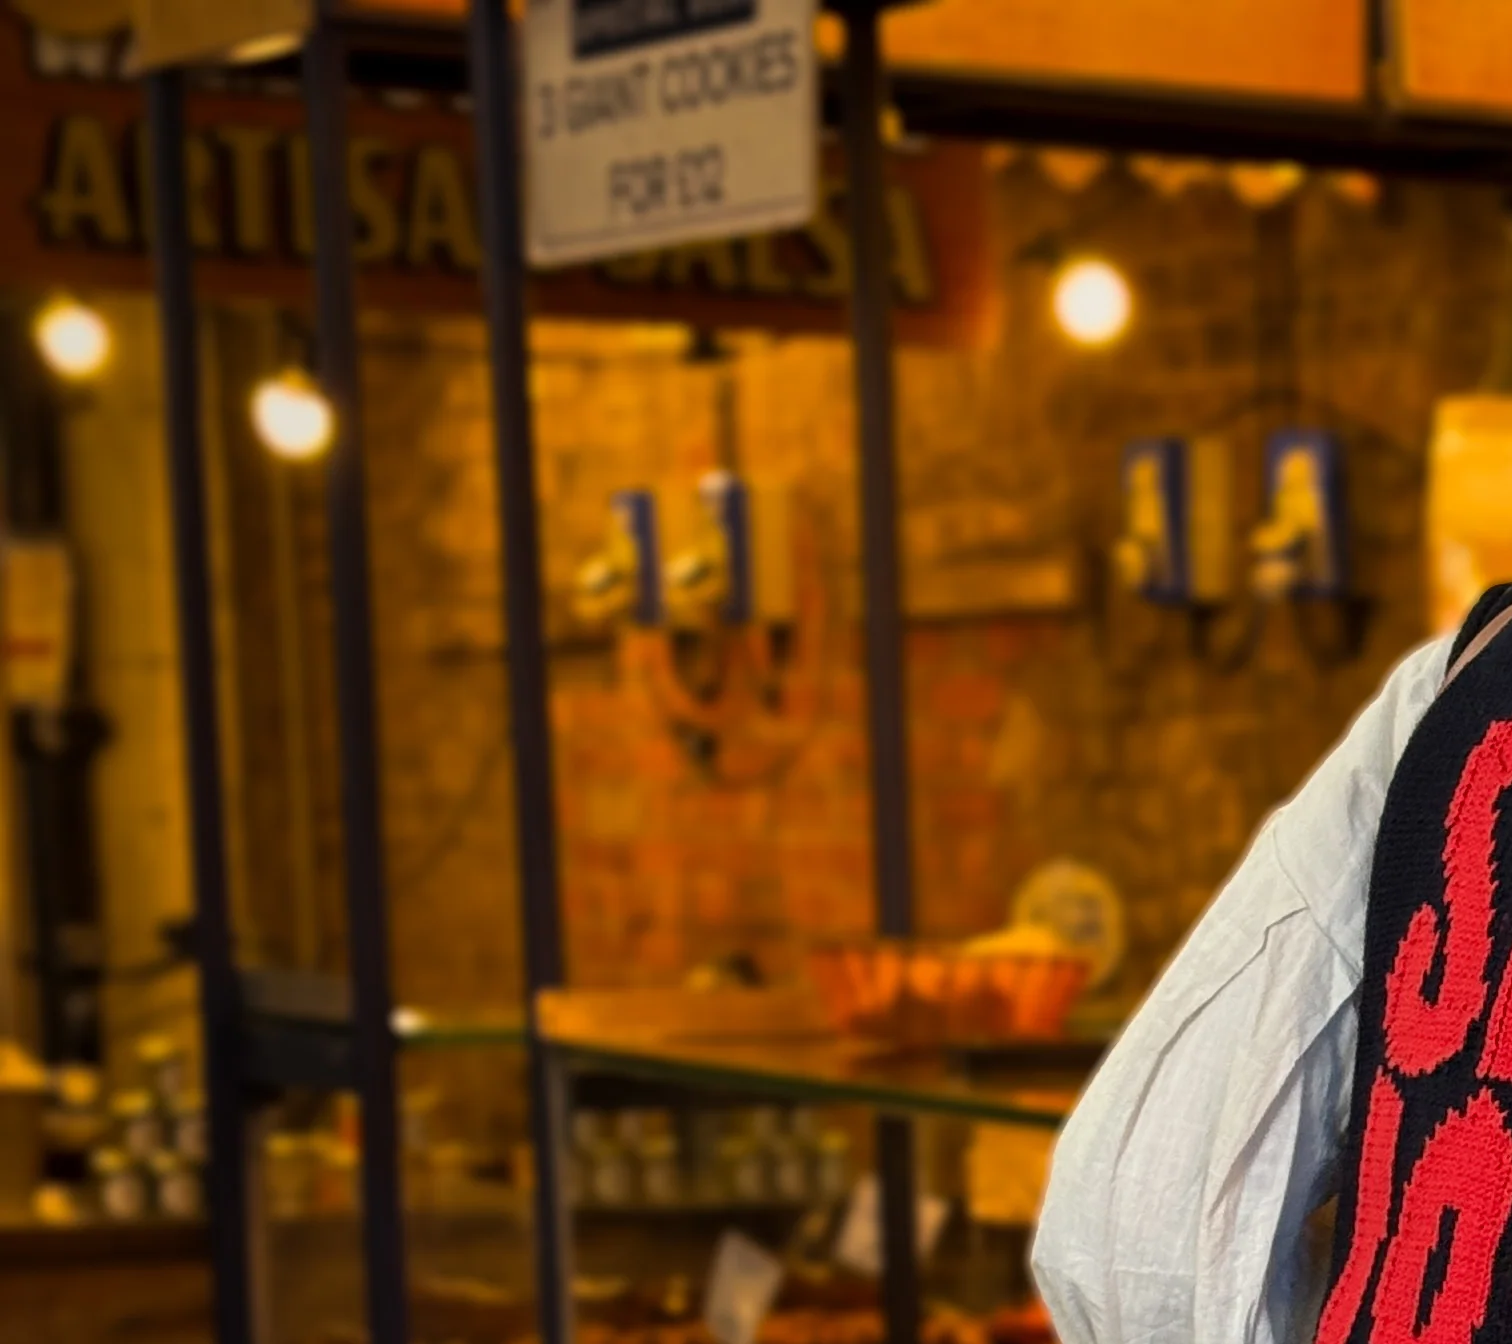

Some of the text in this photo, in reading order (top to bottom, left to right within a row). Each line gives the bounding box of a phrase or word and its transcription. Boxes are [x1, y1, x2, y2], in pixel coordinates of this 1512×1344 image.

[657, 30, 798, 118] COOKIES
[33, 114, 500, 271] ARTISA
[606, 153, 668, 217] FOR
